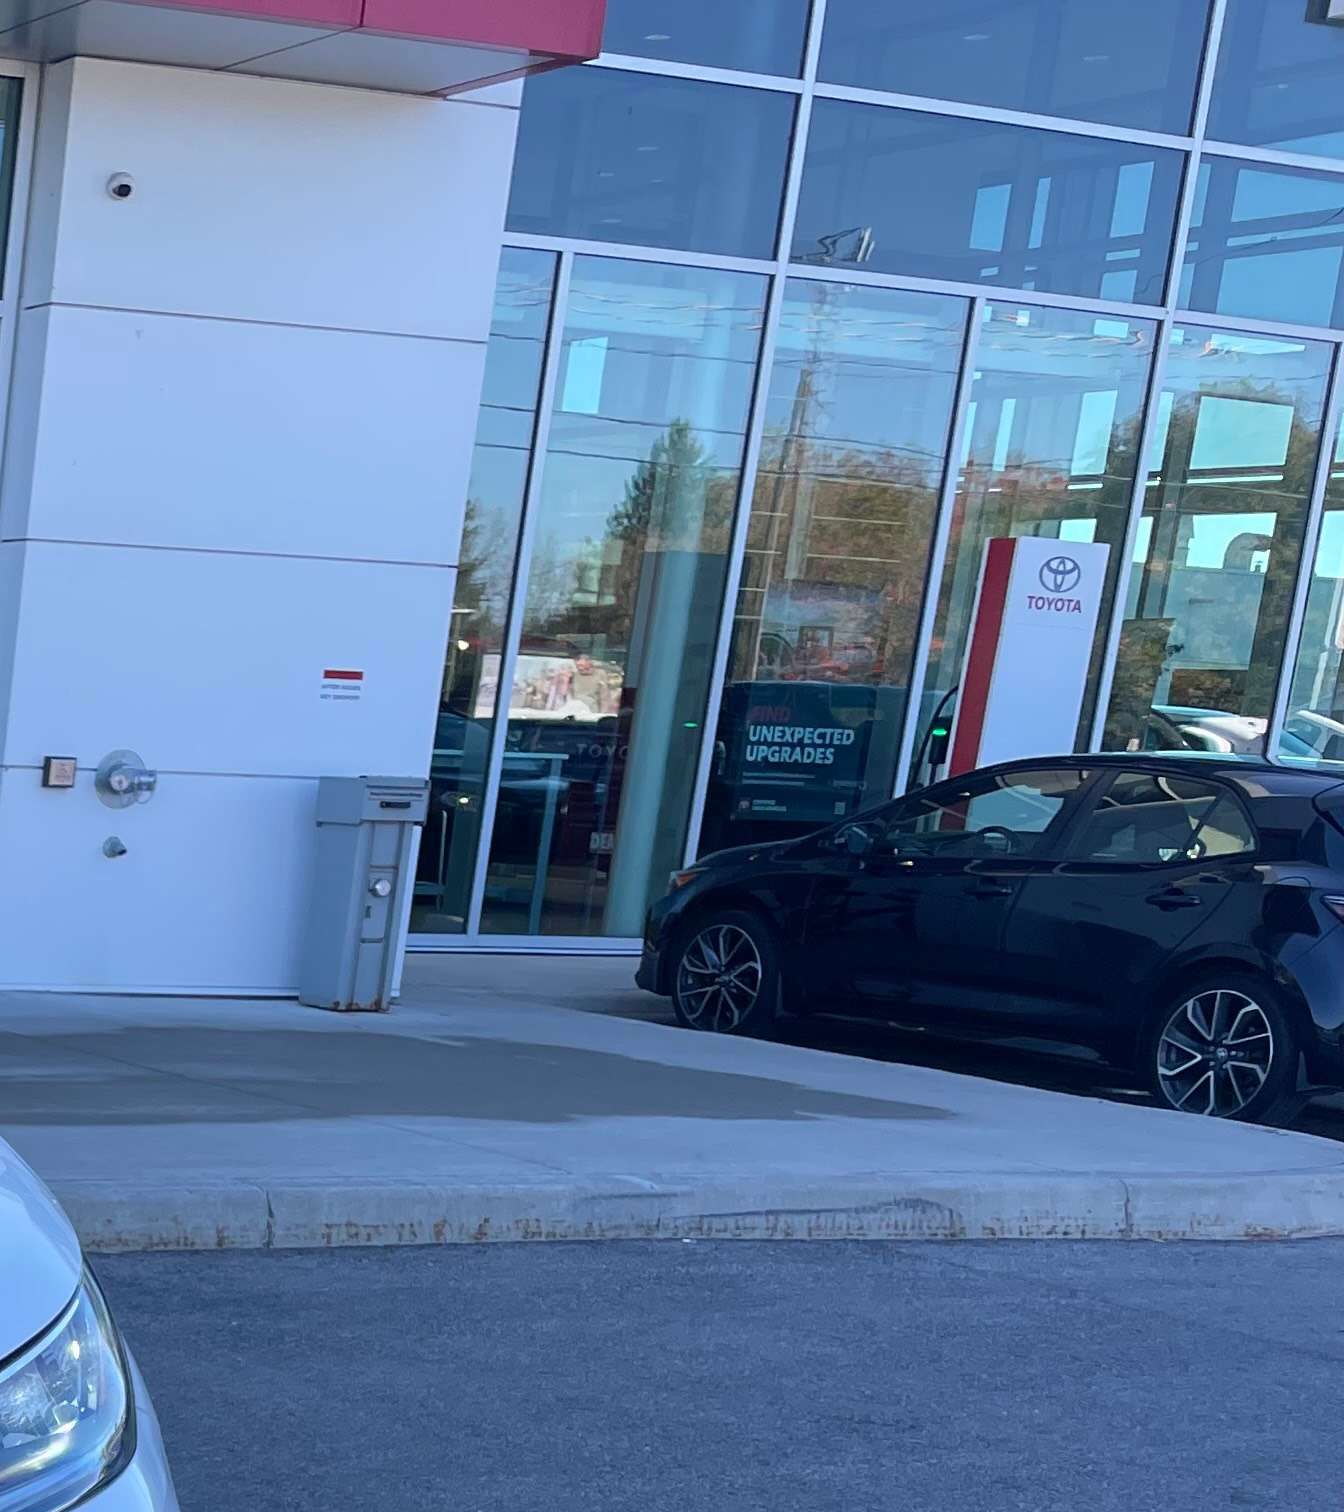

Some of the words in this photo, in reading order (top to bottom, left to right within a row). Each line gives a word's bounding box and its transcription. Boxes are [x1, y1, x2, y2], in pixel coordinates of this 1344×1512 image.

[1027, 595, 1082, 614] TOYOTA
[749, 725, 854, 745] UNEXPECTED
[576, 743, 628, 758] TOYO
[745, 745, 835, 764] UPGRADES
